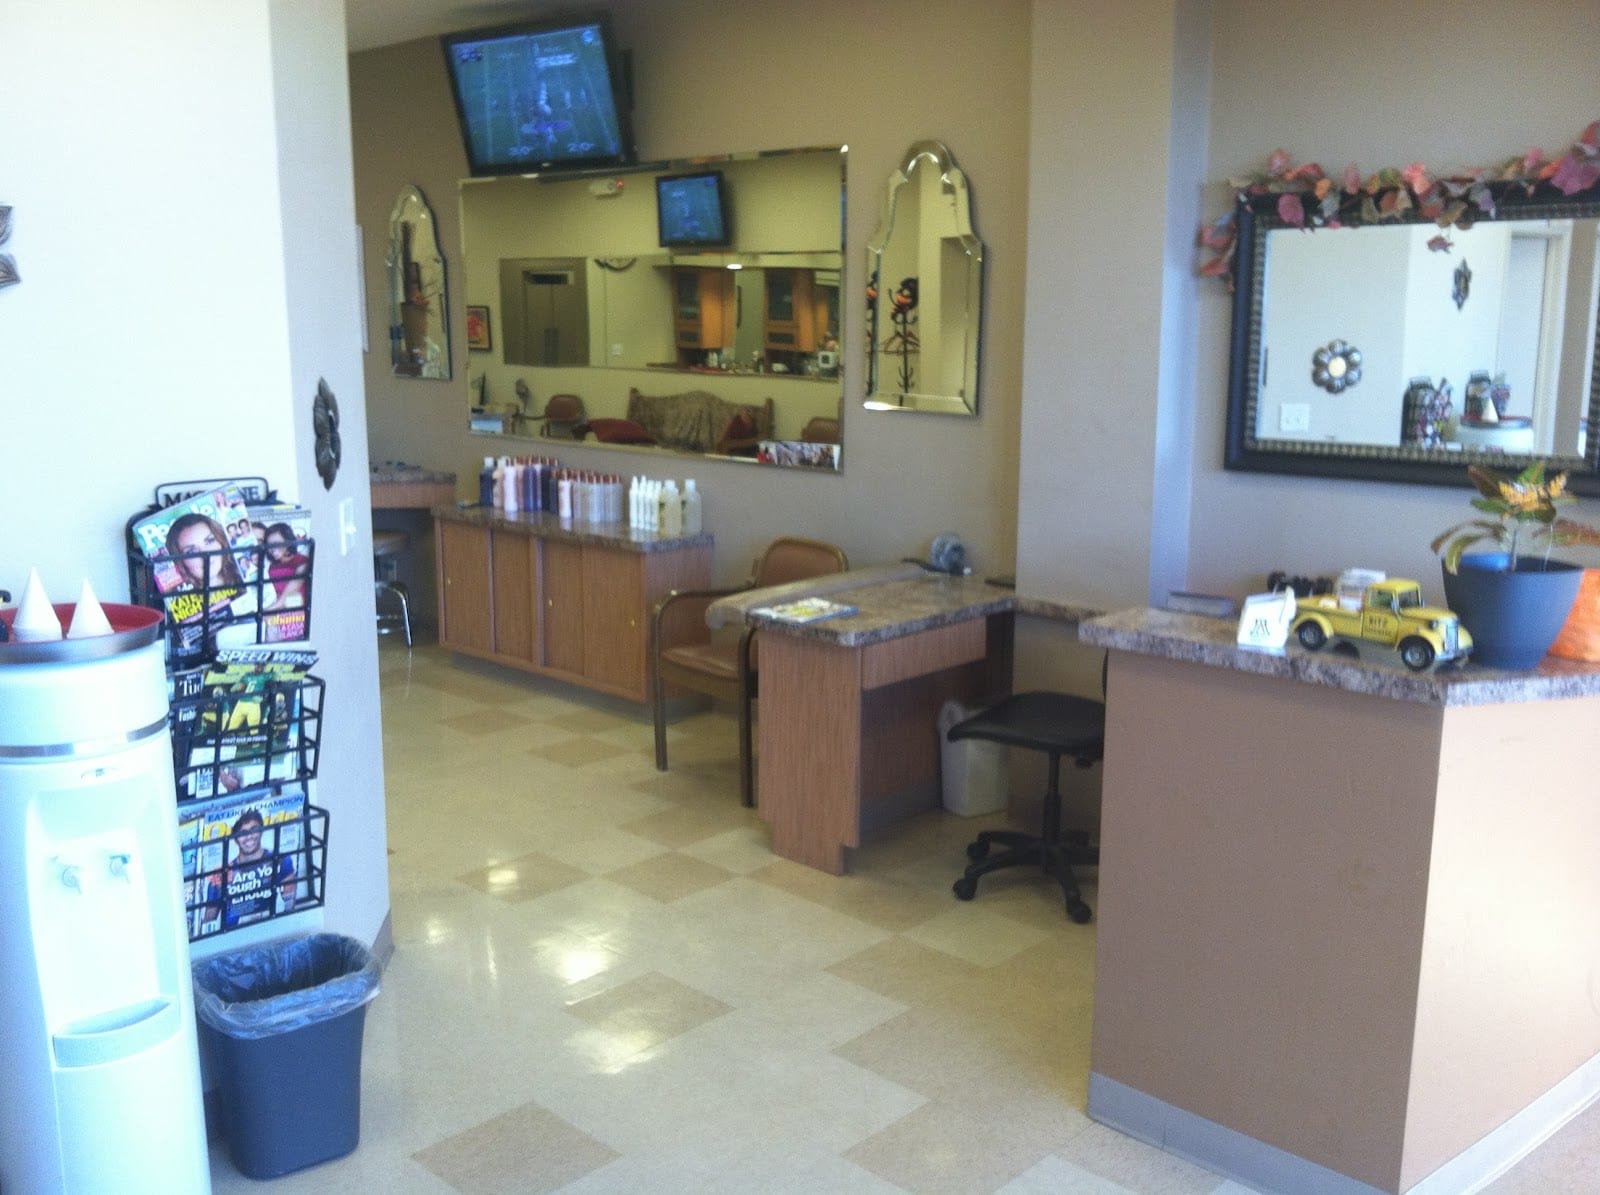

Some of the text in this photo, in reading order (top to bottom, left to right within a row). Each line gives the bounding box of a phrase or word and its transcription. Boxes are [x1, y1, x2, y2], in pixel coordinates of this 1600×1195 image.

[216, 649, 319, 665] SPEED WINS
[254, 794, 304, 811] CHAMPION
[232, 869, 256, 885] Are
[227, 879, 262, 896] ough
